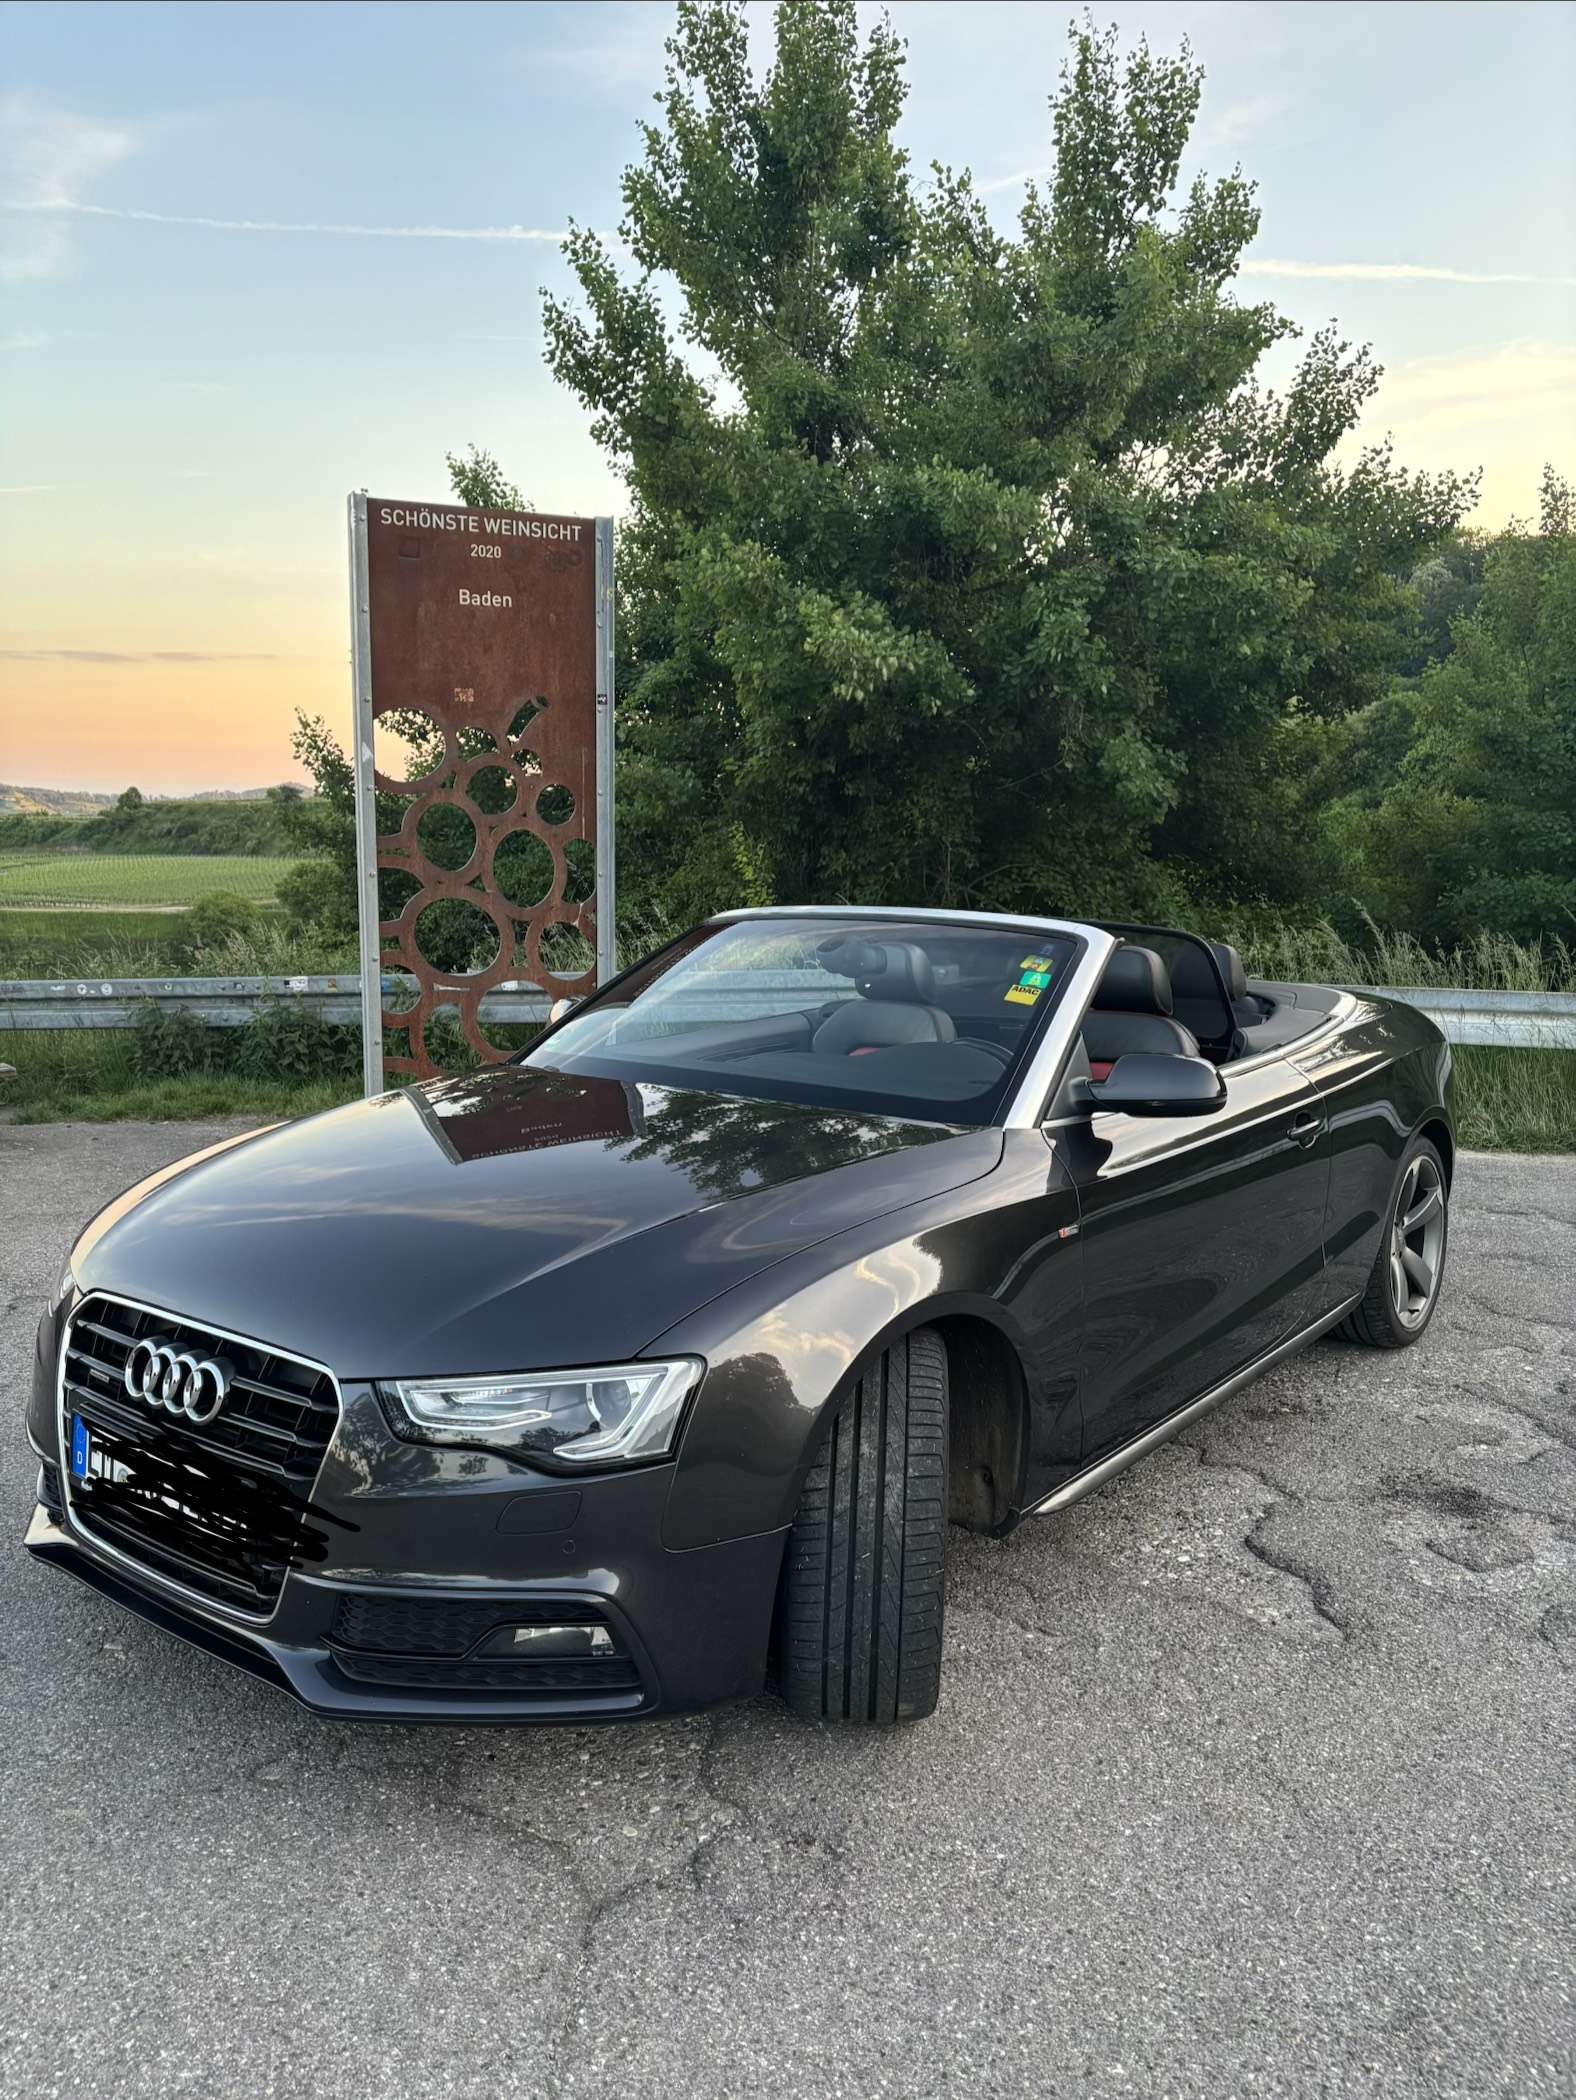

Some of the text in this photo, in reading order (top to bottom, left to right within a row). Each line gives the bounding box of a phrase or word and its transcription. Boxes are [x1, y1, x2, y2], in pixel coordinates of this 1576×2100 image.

[380, 508, 582, 541] SCHÖNSTE WEINSICHT
[470, 544, 502, 559] 2020
[459, 589, 512, 608] Baden
[1012, 986, 1039, 996] ADAC
[77, 1450, 83, 1465] D
